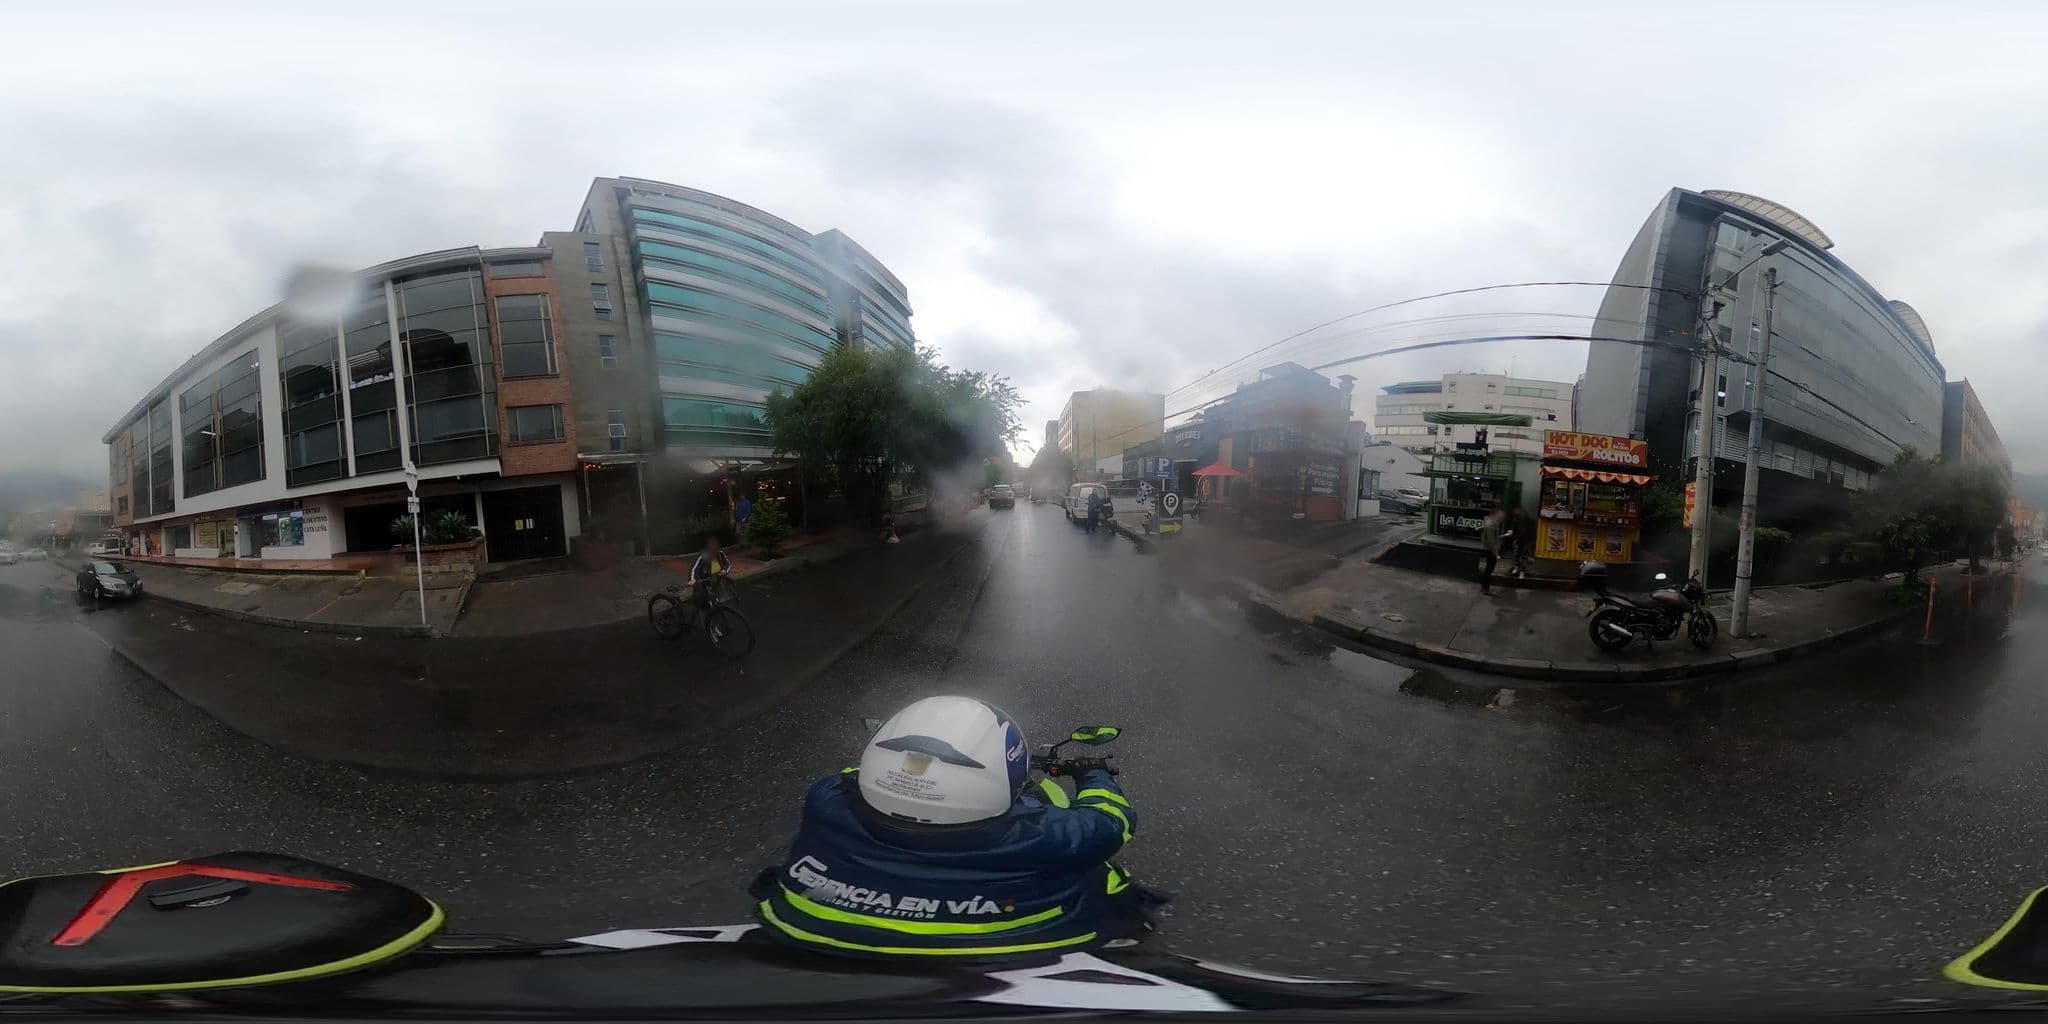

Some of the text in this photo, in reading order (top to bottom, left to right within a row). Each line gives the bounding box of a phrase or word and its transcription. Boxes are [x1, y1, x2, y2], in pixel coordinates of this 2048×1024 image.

[1550, 432, 1608, 448] HOT DOG
[1159, 457, 1169, 471] P
[1592, 449, 1640, 464] ROLITOS
[1168, 497, 1175, 506] P
[1440, 514, 1486, 531] La Arep
[895, 896, 940, 913] EN
[946, 895, 1001, 915] VÍA
[874, 907, 936, 919] GESTIÓN
